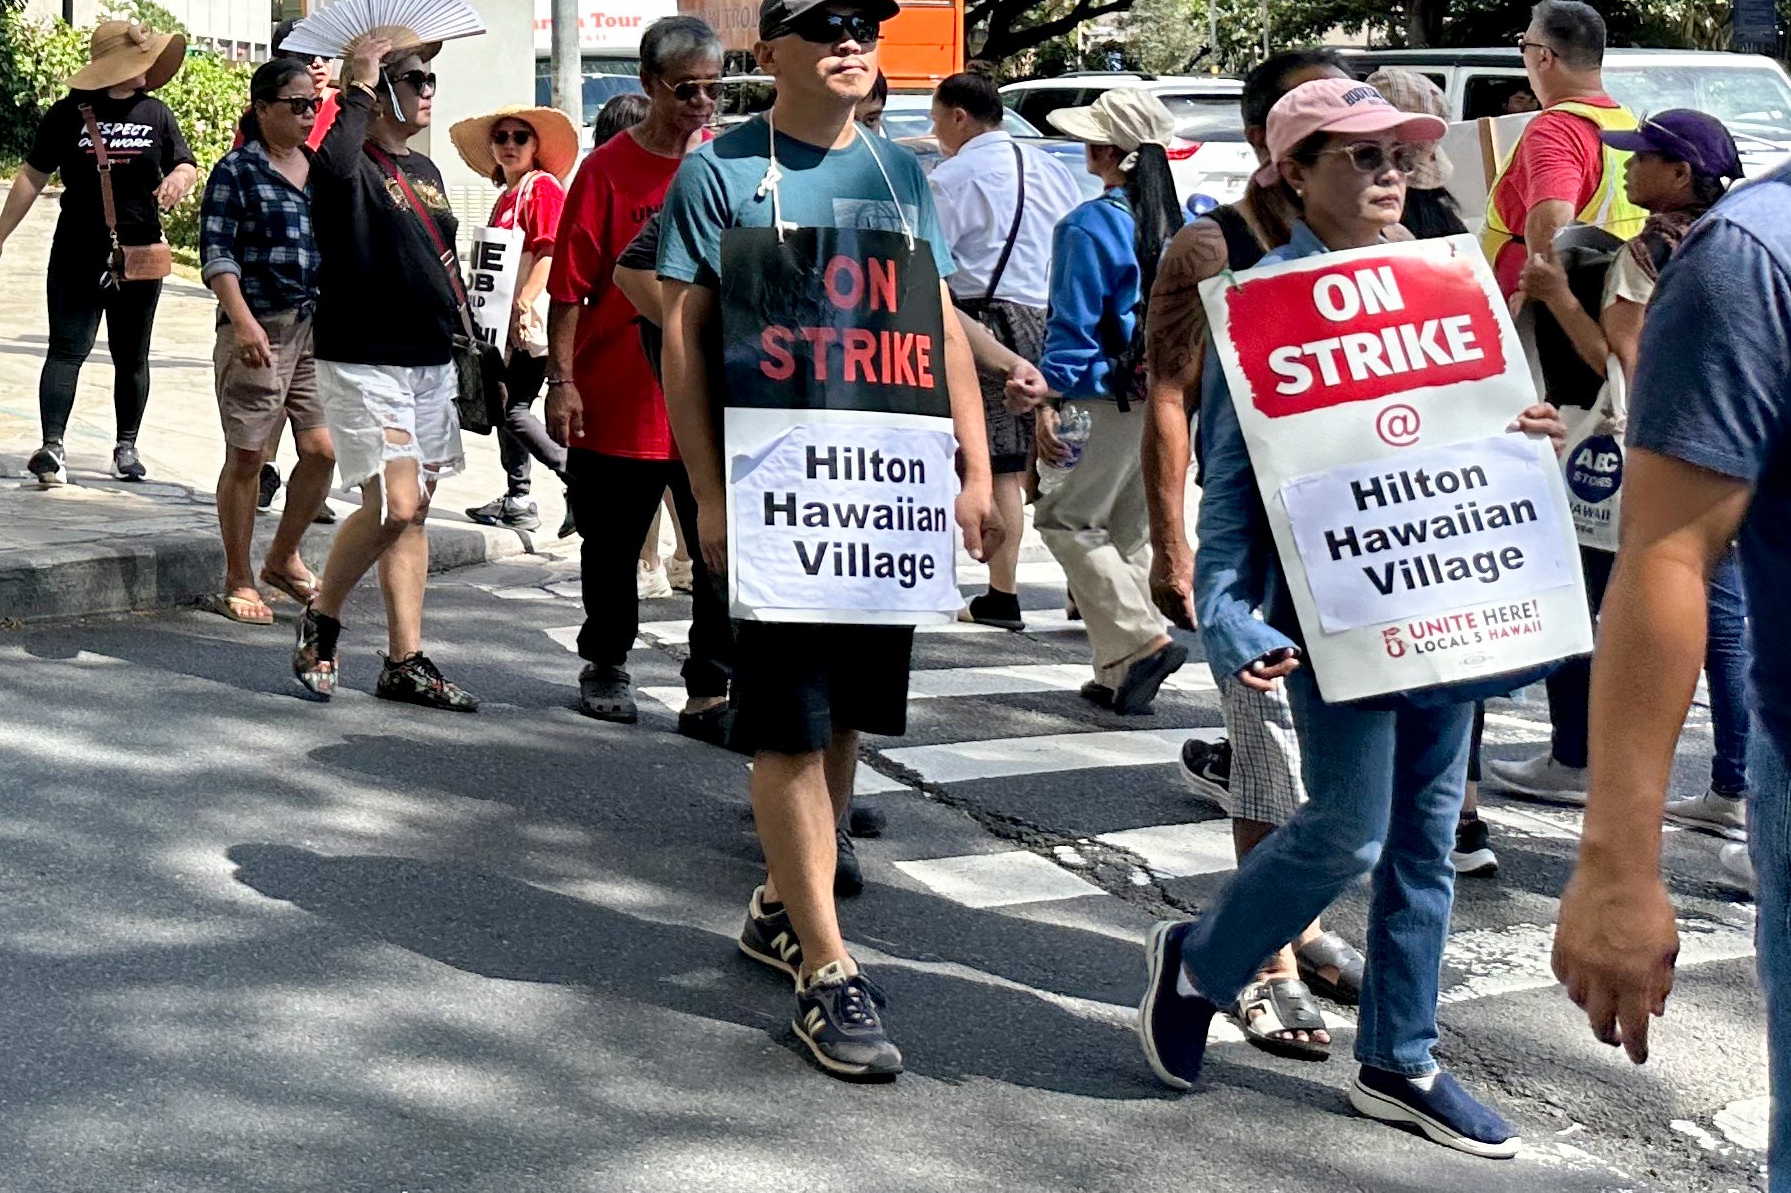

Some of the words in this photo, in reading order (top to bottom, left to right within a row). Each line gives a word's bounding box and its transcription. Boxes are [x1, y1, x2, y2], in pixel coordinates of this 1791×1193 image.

[590, 12, 642, 28] Tour
[109, 137, 154, 149] WORK
[823, 254, 898, 314] ON
[1312, 265, 1406, 323] ON
[760, 324, 935, 389] STRIKE
[1268, 313, 1485, 396] STRIKE
[1375, 403, 1421, 447] @
[805, 444, 926, 485] Hilton
[1575, 448, 1619, 473] ABC
[1349, 464, 1489, 512] Hilton
[763, 491, 947, 533] Hawaiian
[1323, 498, 1538, 562] Hawaiian
[1570, 502, 1611, 522] AWAII
[792, 539, 936, 589] Village
[1361, 545, 1525, 596] Village
[1408, 611, 1478, 640] UNITE
[1482, 598, 1540, 627] HERE!
[1414, 633, 1470, 655] LOCAL
[1473, 631, 1483, 644] 5
[1487, 619, 1543, 642] HAWAII
